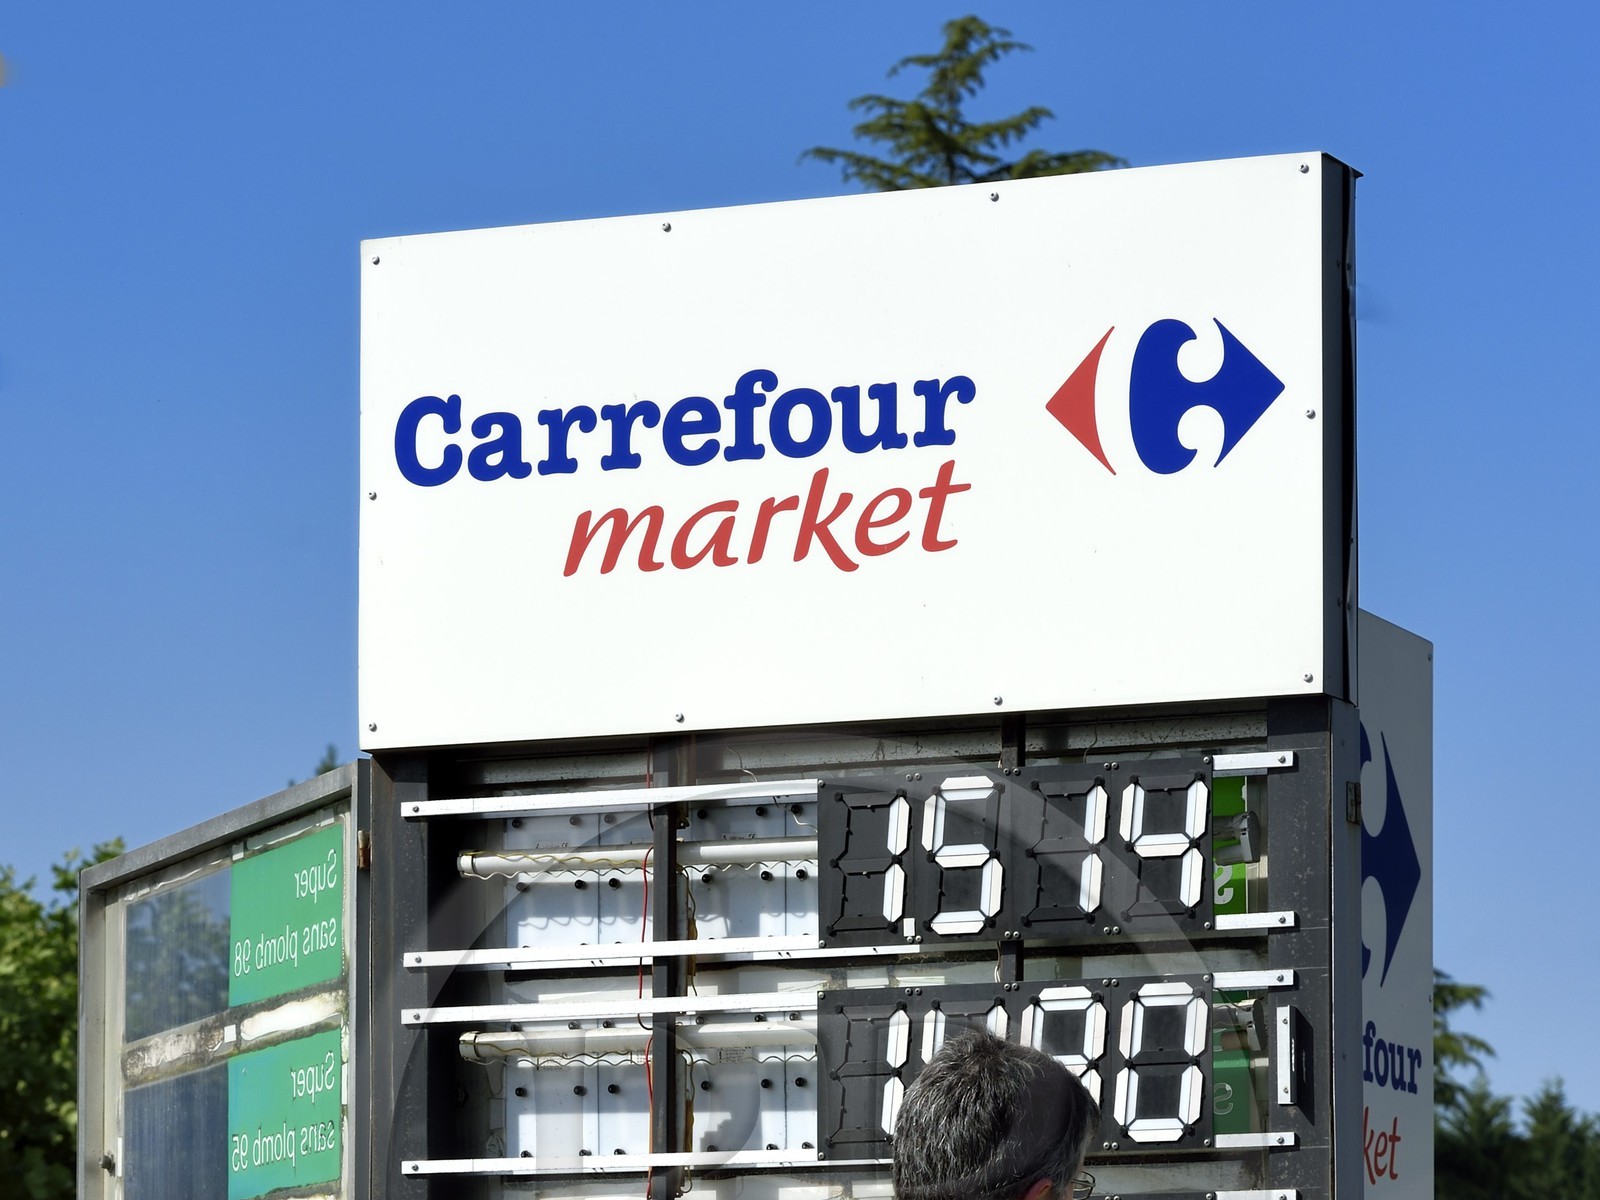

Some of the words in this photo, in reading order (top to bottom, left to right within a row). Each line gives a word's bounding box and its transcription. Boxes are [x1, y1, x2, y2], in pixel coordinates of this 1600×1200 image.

[394, 367, 976, 488] Carrefour
[562, 459, 972, 578] market
[1362, 1105, 1402, 1186] ket
